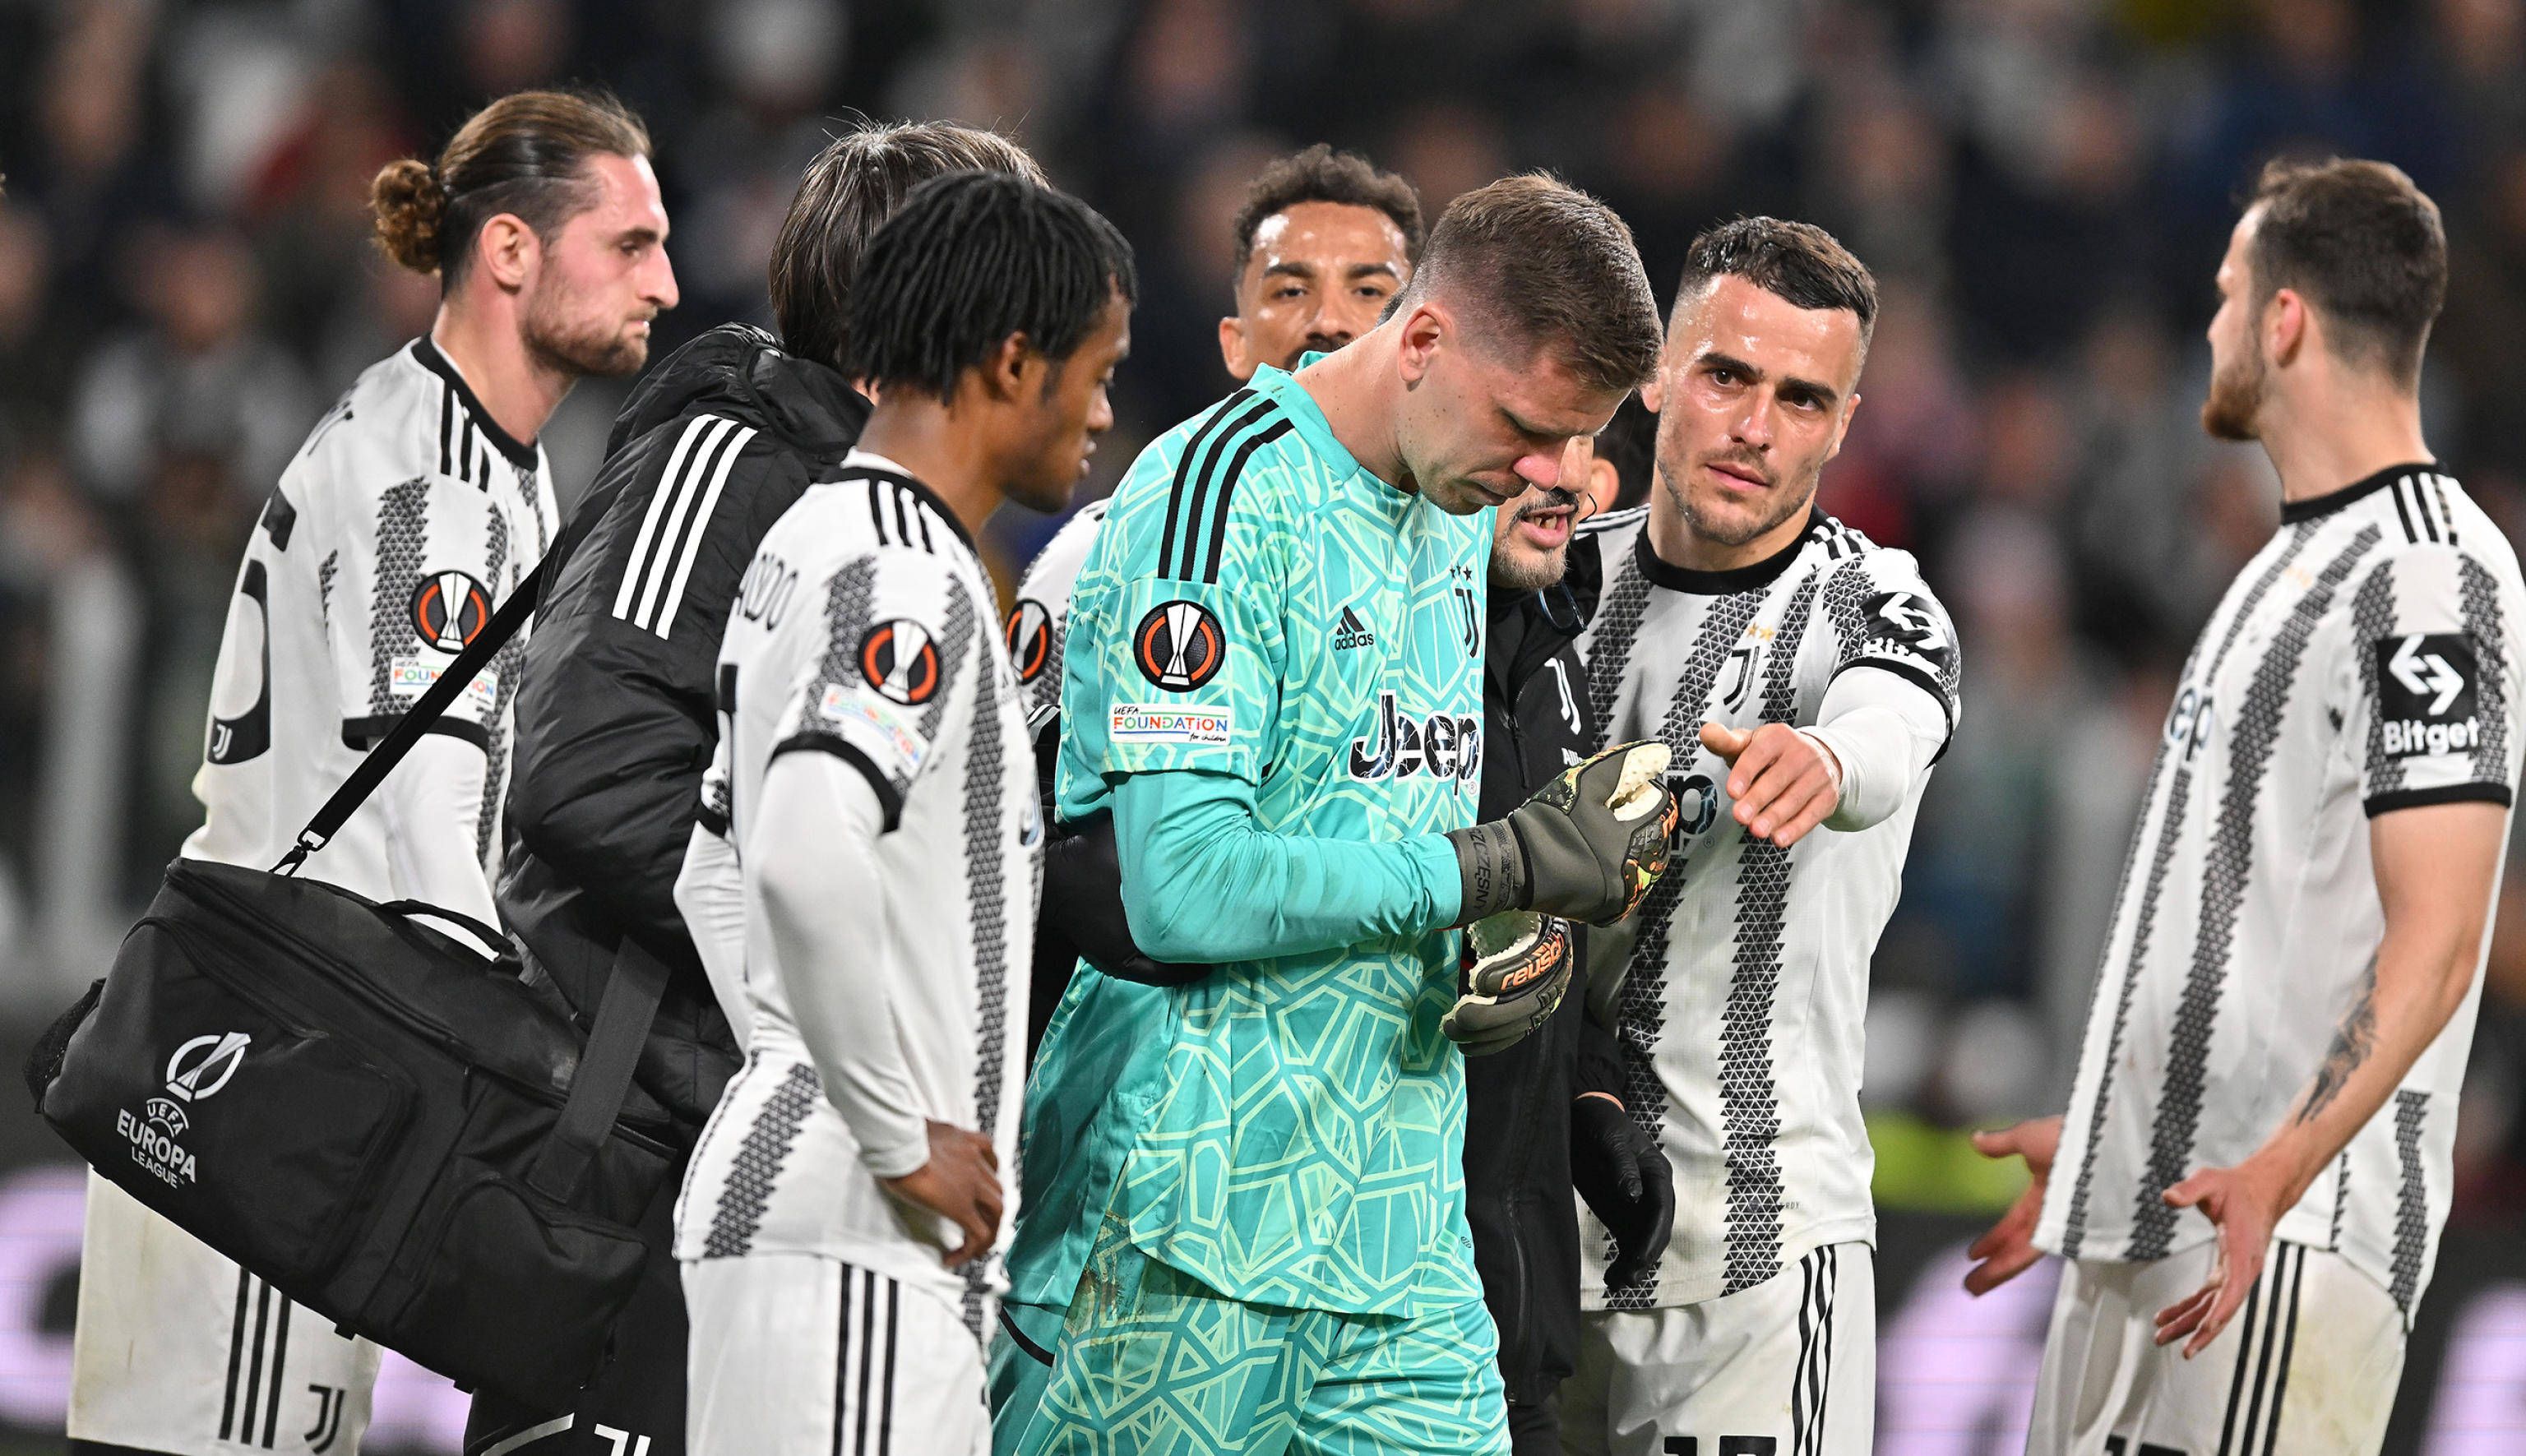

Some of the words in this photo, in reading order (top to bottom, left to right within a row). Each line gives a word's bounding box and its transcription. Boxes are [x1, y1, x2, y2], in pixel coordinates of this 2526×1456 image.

[1113, 706, 1140, 715] UEFA
[1349, 692, 1481, 797] Jeep
[2385, 717, 2480, 756] Bitget
[147, 1103, 184, 1136] UEFA
[117, 1107, 197, 1184] EUROPA
[132, 1146, 178, 1190] LEAGUE
